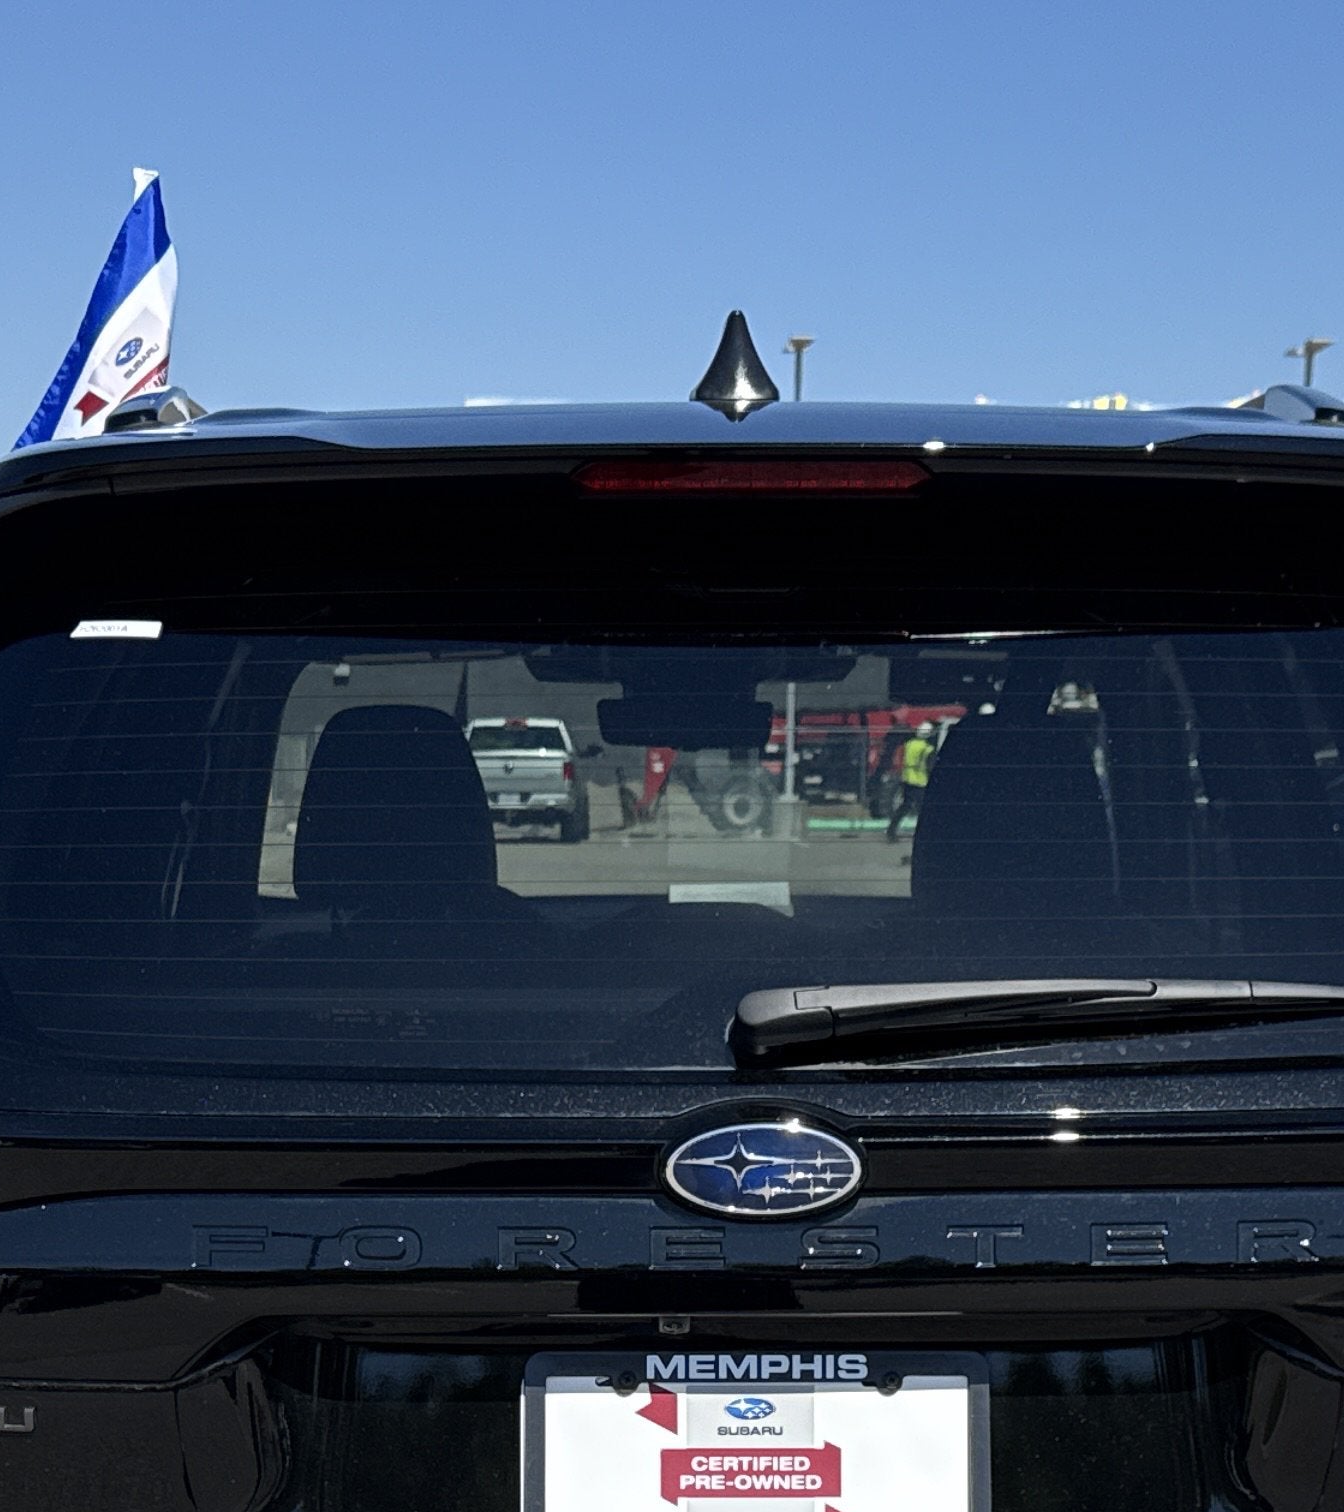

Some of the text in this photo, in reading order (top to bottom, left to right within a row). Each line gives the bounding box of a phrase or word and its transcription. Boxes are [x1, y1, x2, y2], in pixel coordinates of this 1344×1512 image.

[192, 1219, 1319, 1271] FORESTER
[646, 1354, 868, 1380] MEMPHIS
[717, 1426, 783, 1436] SUBARU
[690, 1456, 811, 1472] CERTIFIED
[679, 1474, 822, 1490] PRE-OWNED
